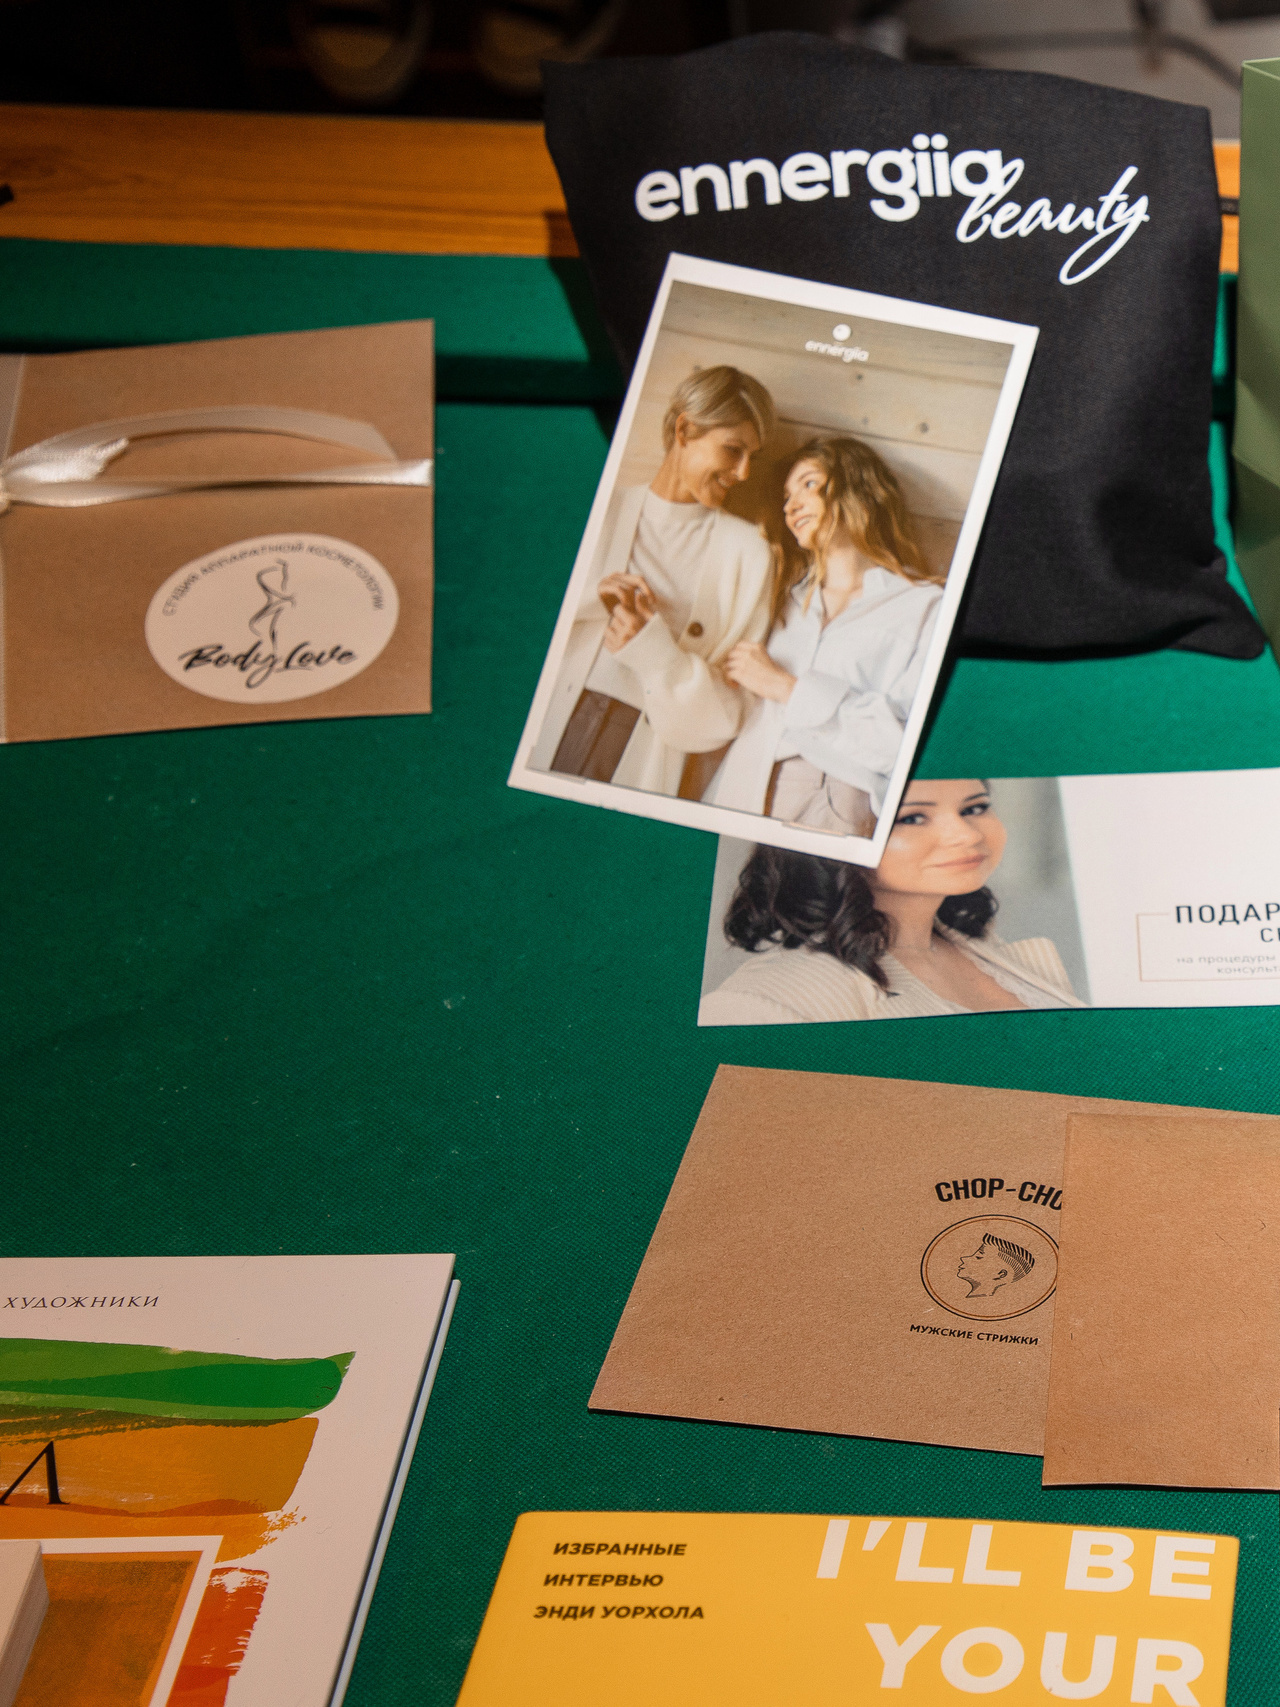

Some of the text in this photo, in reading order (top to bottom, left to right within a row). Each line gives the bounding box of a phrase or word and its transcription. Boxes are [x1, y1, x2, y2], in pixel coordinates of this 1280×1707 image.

[635, 133, 1004, 222] ennergiia
[955, 158, 1150, 285] beauty
[1177, 955, 1194, 965] на
[1198, 952, 1277, 967] процедуры
[3, 1295, 159, 1310] ХУДОЖНИКИ
[910, 1323, 1039, 1346] МУЖСКИЕ СТРИЖКИ
[553, 1542, 688, 1556] ИЗБРАННЫЕ
[1064, 1530, 1217, 1600] BE
[543, 1574, 664, 1587] ИНТЕРВЬЮ
[533, 1605, 704, 1621] ЭНДИ УОРХОЛА
[864, 1622, 1205, 1707] YOUR
